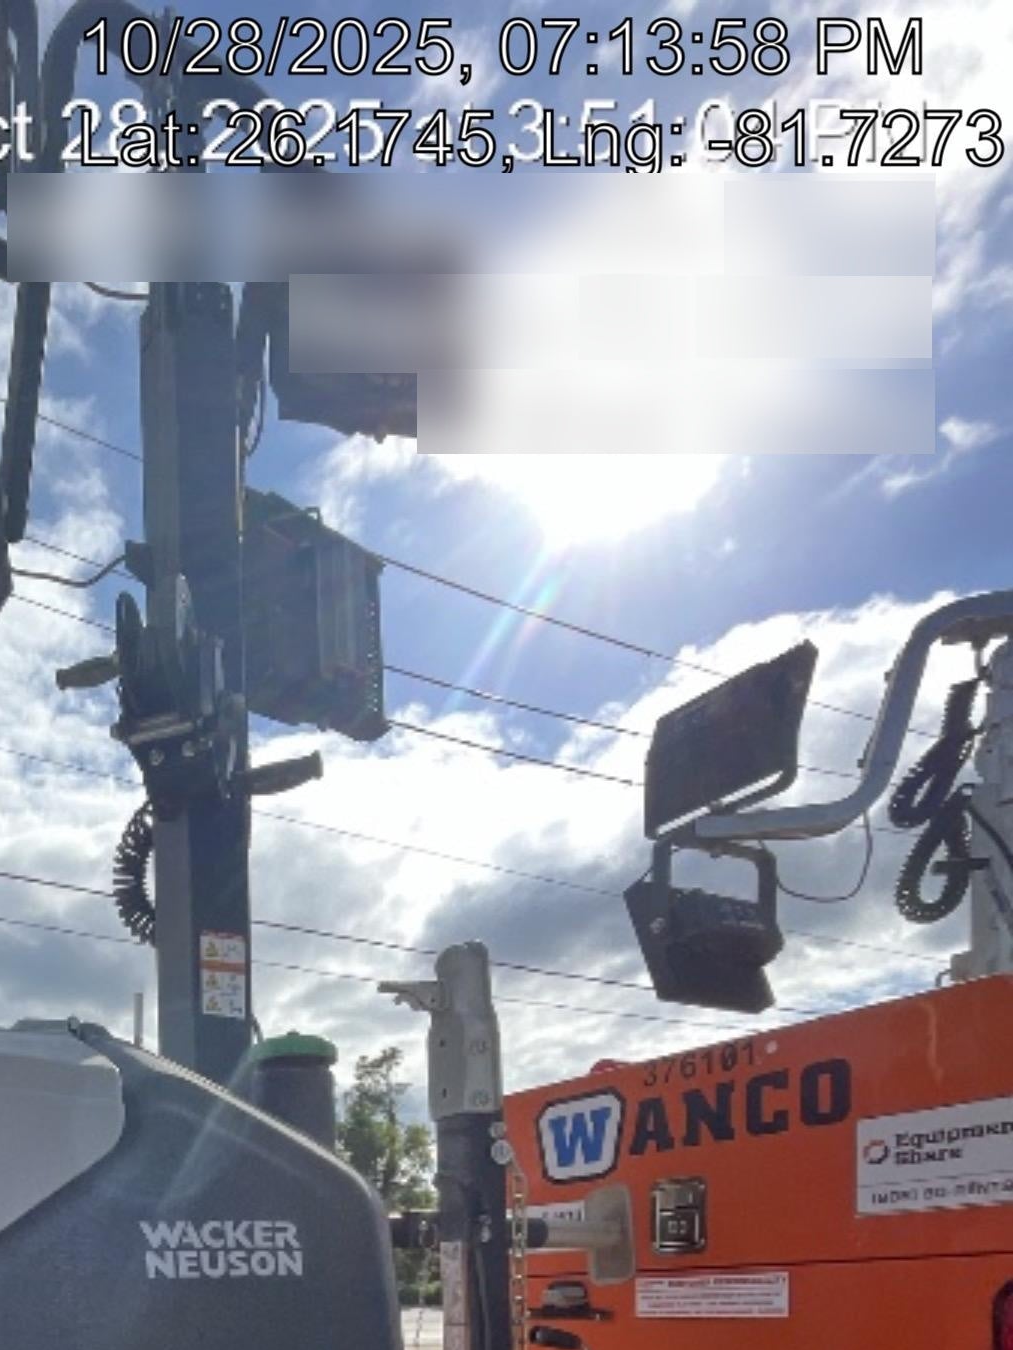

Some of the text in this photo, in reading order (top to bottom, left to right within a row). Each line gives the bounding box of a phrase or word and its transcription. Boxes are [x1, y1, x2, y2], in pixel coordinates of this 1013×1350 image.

[547, 1057, 853, 1169] WANCO
[895, 1148, 963, 1165] Share
[139, 1220, 301, 1249] WACKER
[145, 1250, 303, 1279] NEUSON
